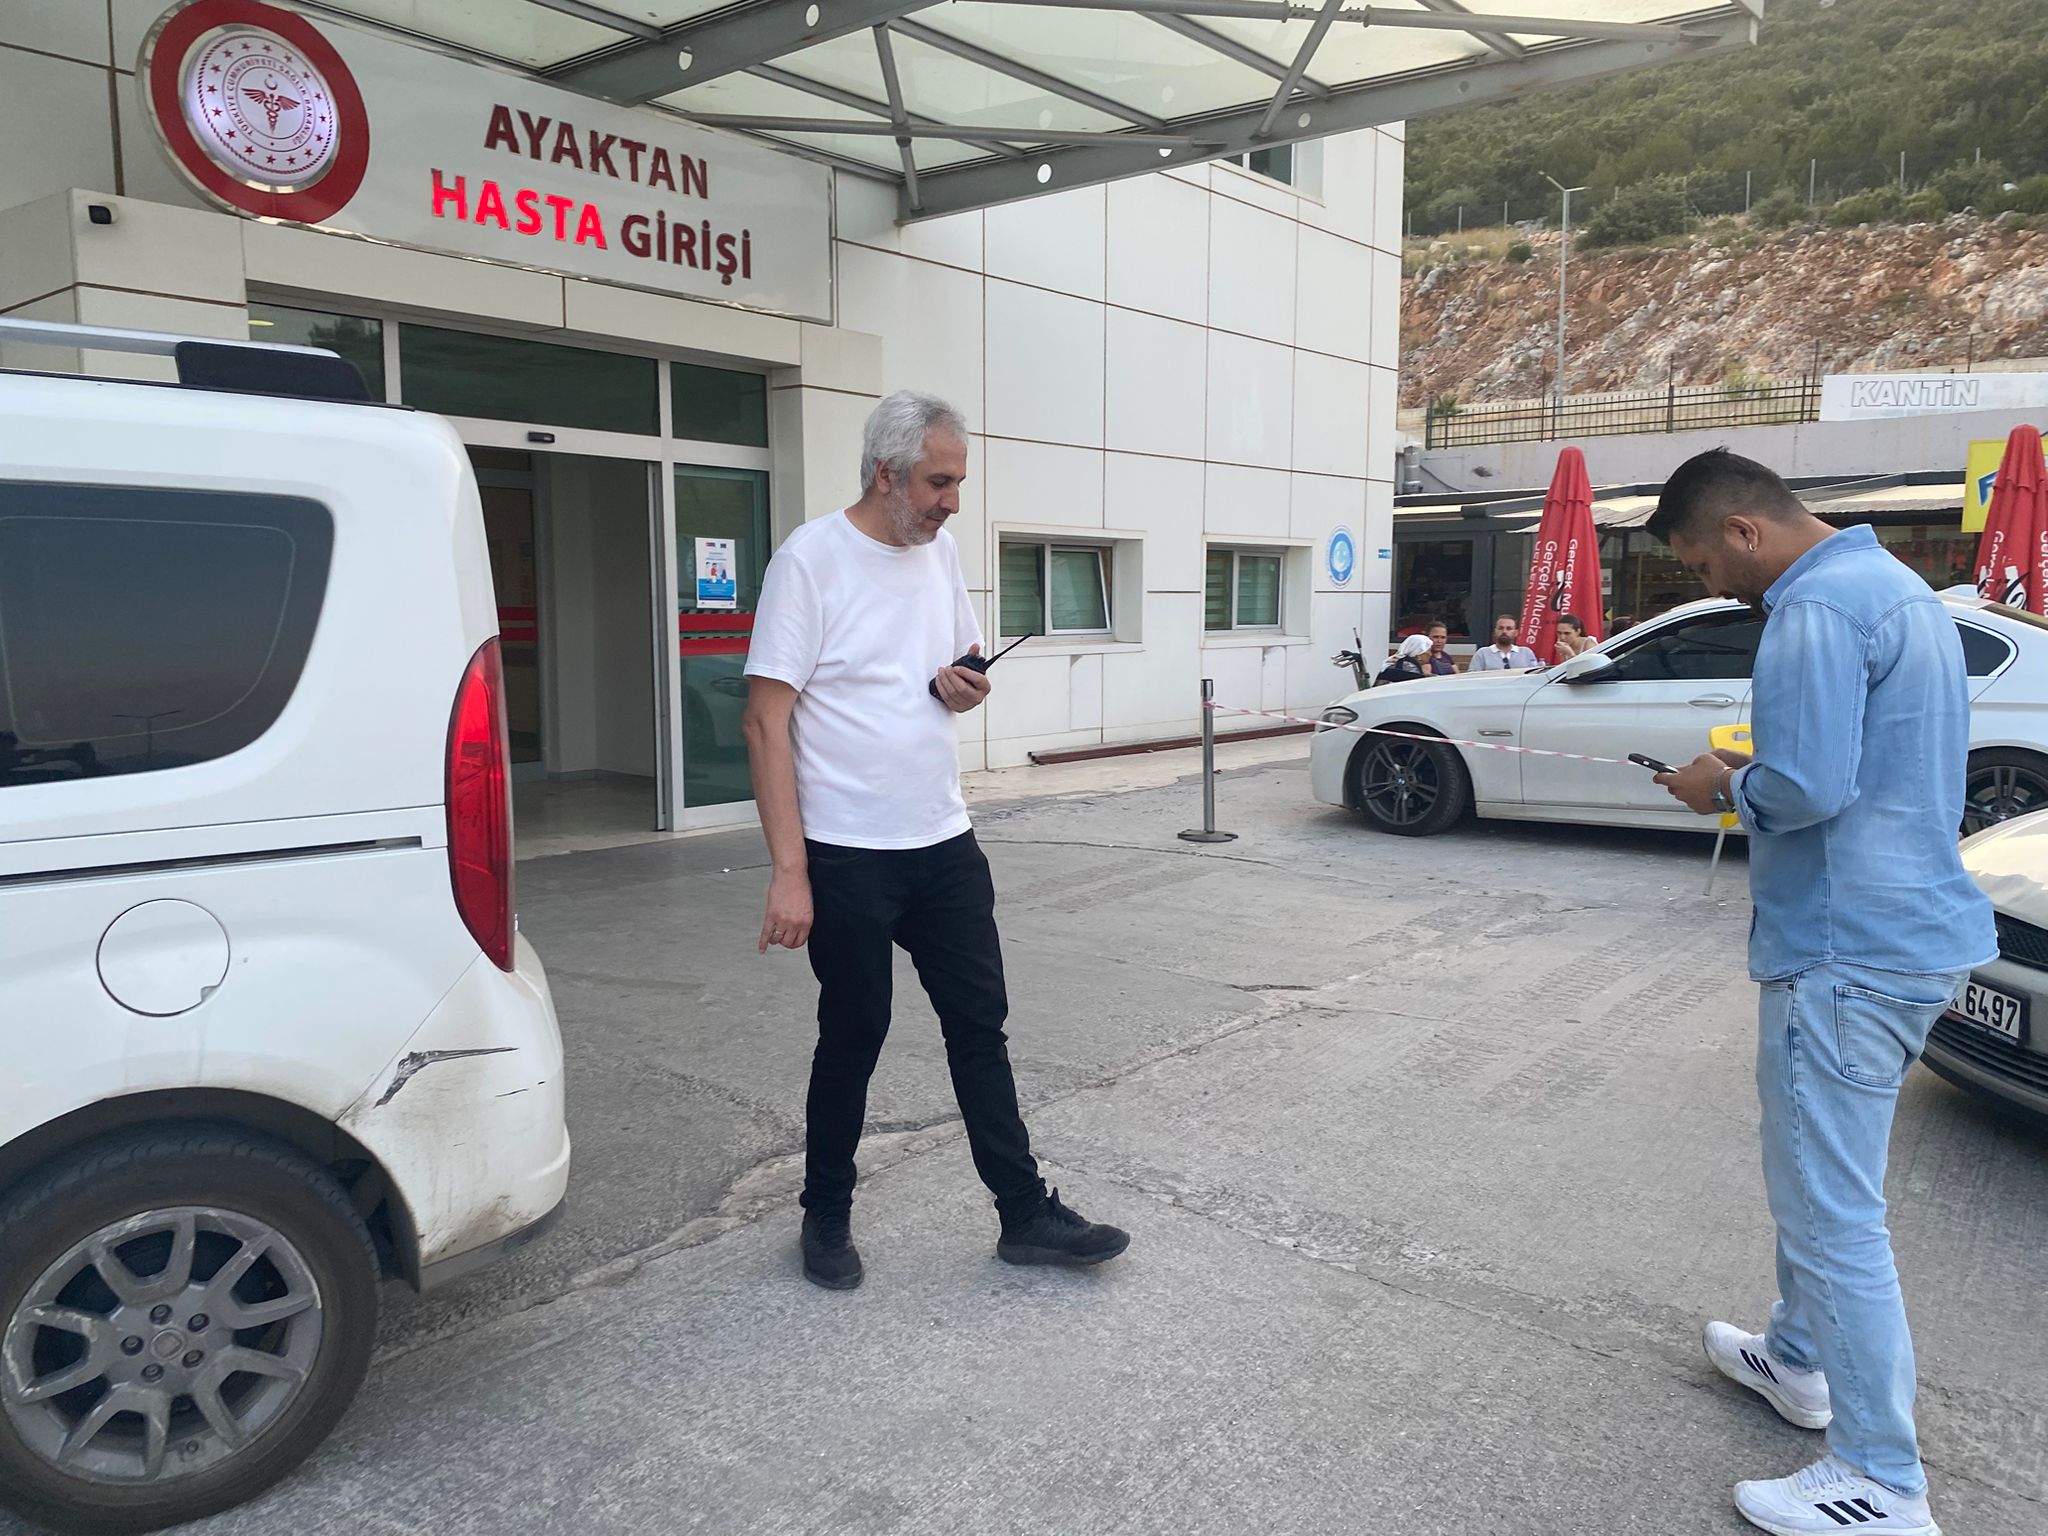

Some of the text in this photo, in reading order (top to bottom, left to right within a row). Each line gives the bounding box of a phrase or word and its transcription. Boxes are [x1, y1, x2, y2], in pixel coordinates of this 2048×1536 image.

[484, 104, 709, 199] AYAKTAN
[430, 168, 752, 286] HASTA GİRİŞİ
[1536, 540, 1558, 591] Gerçek
[1527, 594, 1548, 645] Mucize
[1966, 984, 2018, 1031] 6497
